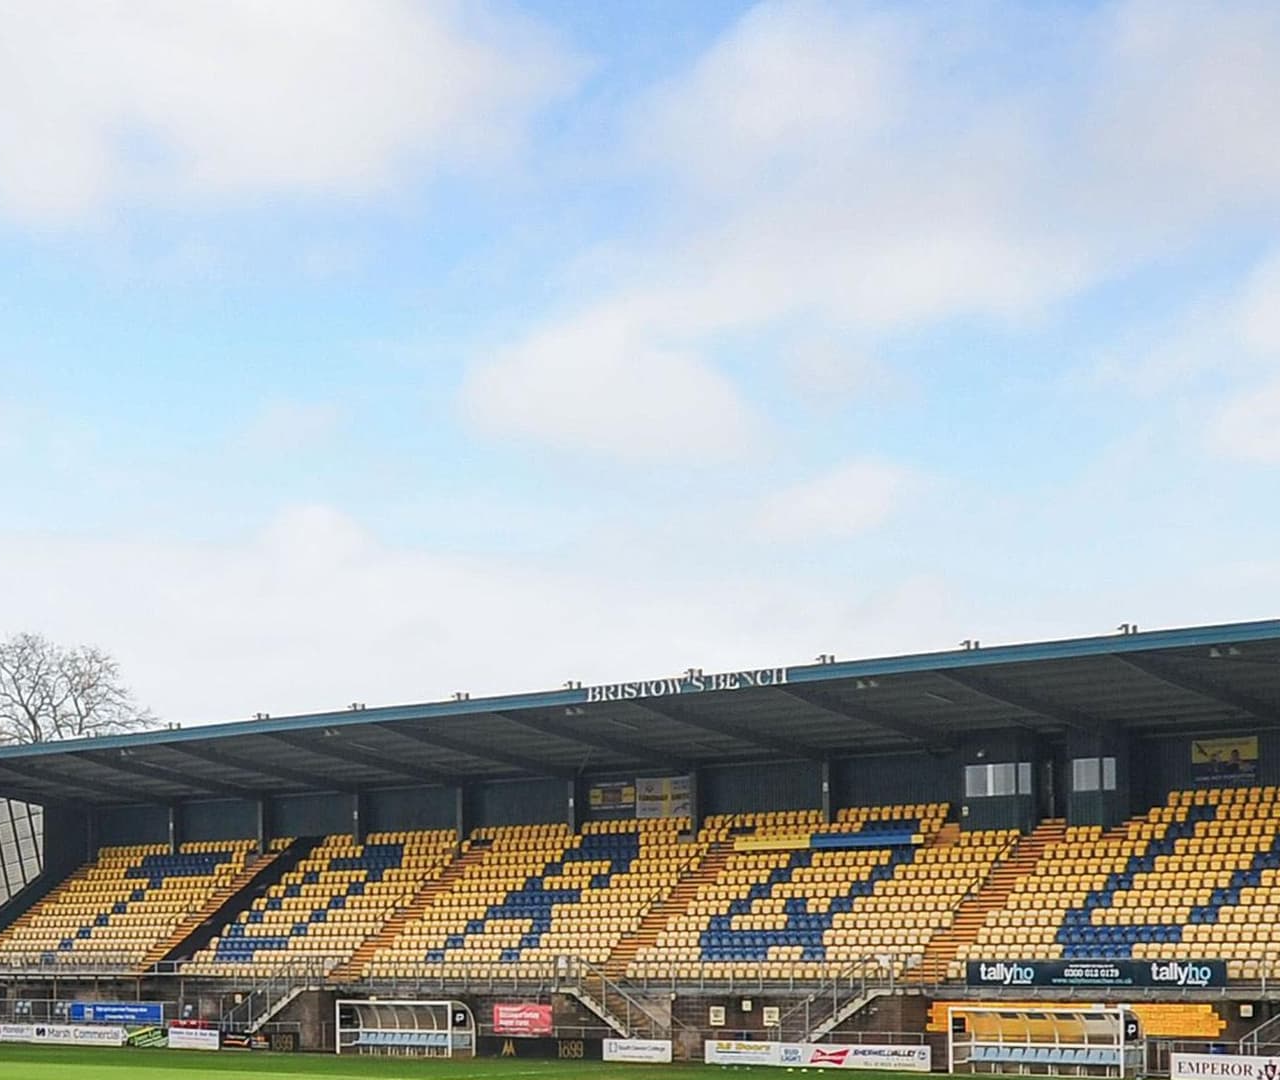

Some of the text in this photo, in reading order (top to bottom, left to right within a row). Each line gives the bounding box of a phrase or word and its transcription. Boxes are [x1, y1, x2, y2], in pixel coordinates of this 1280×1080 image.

[587, 668, 788, 702] BRISTOW'S BENCH
[980, 963, 1034, 984] tallyho
[1151, 962, 1211, 985] tallyho
[1178, 1061, 1253, 1077] EMPEROR
